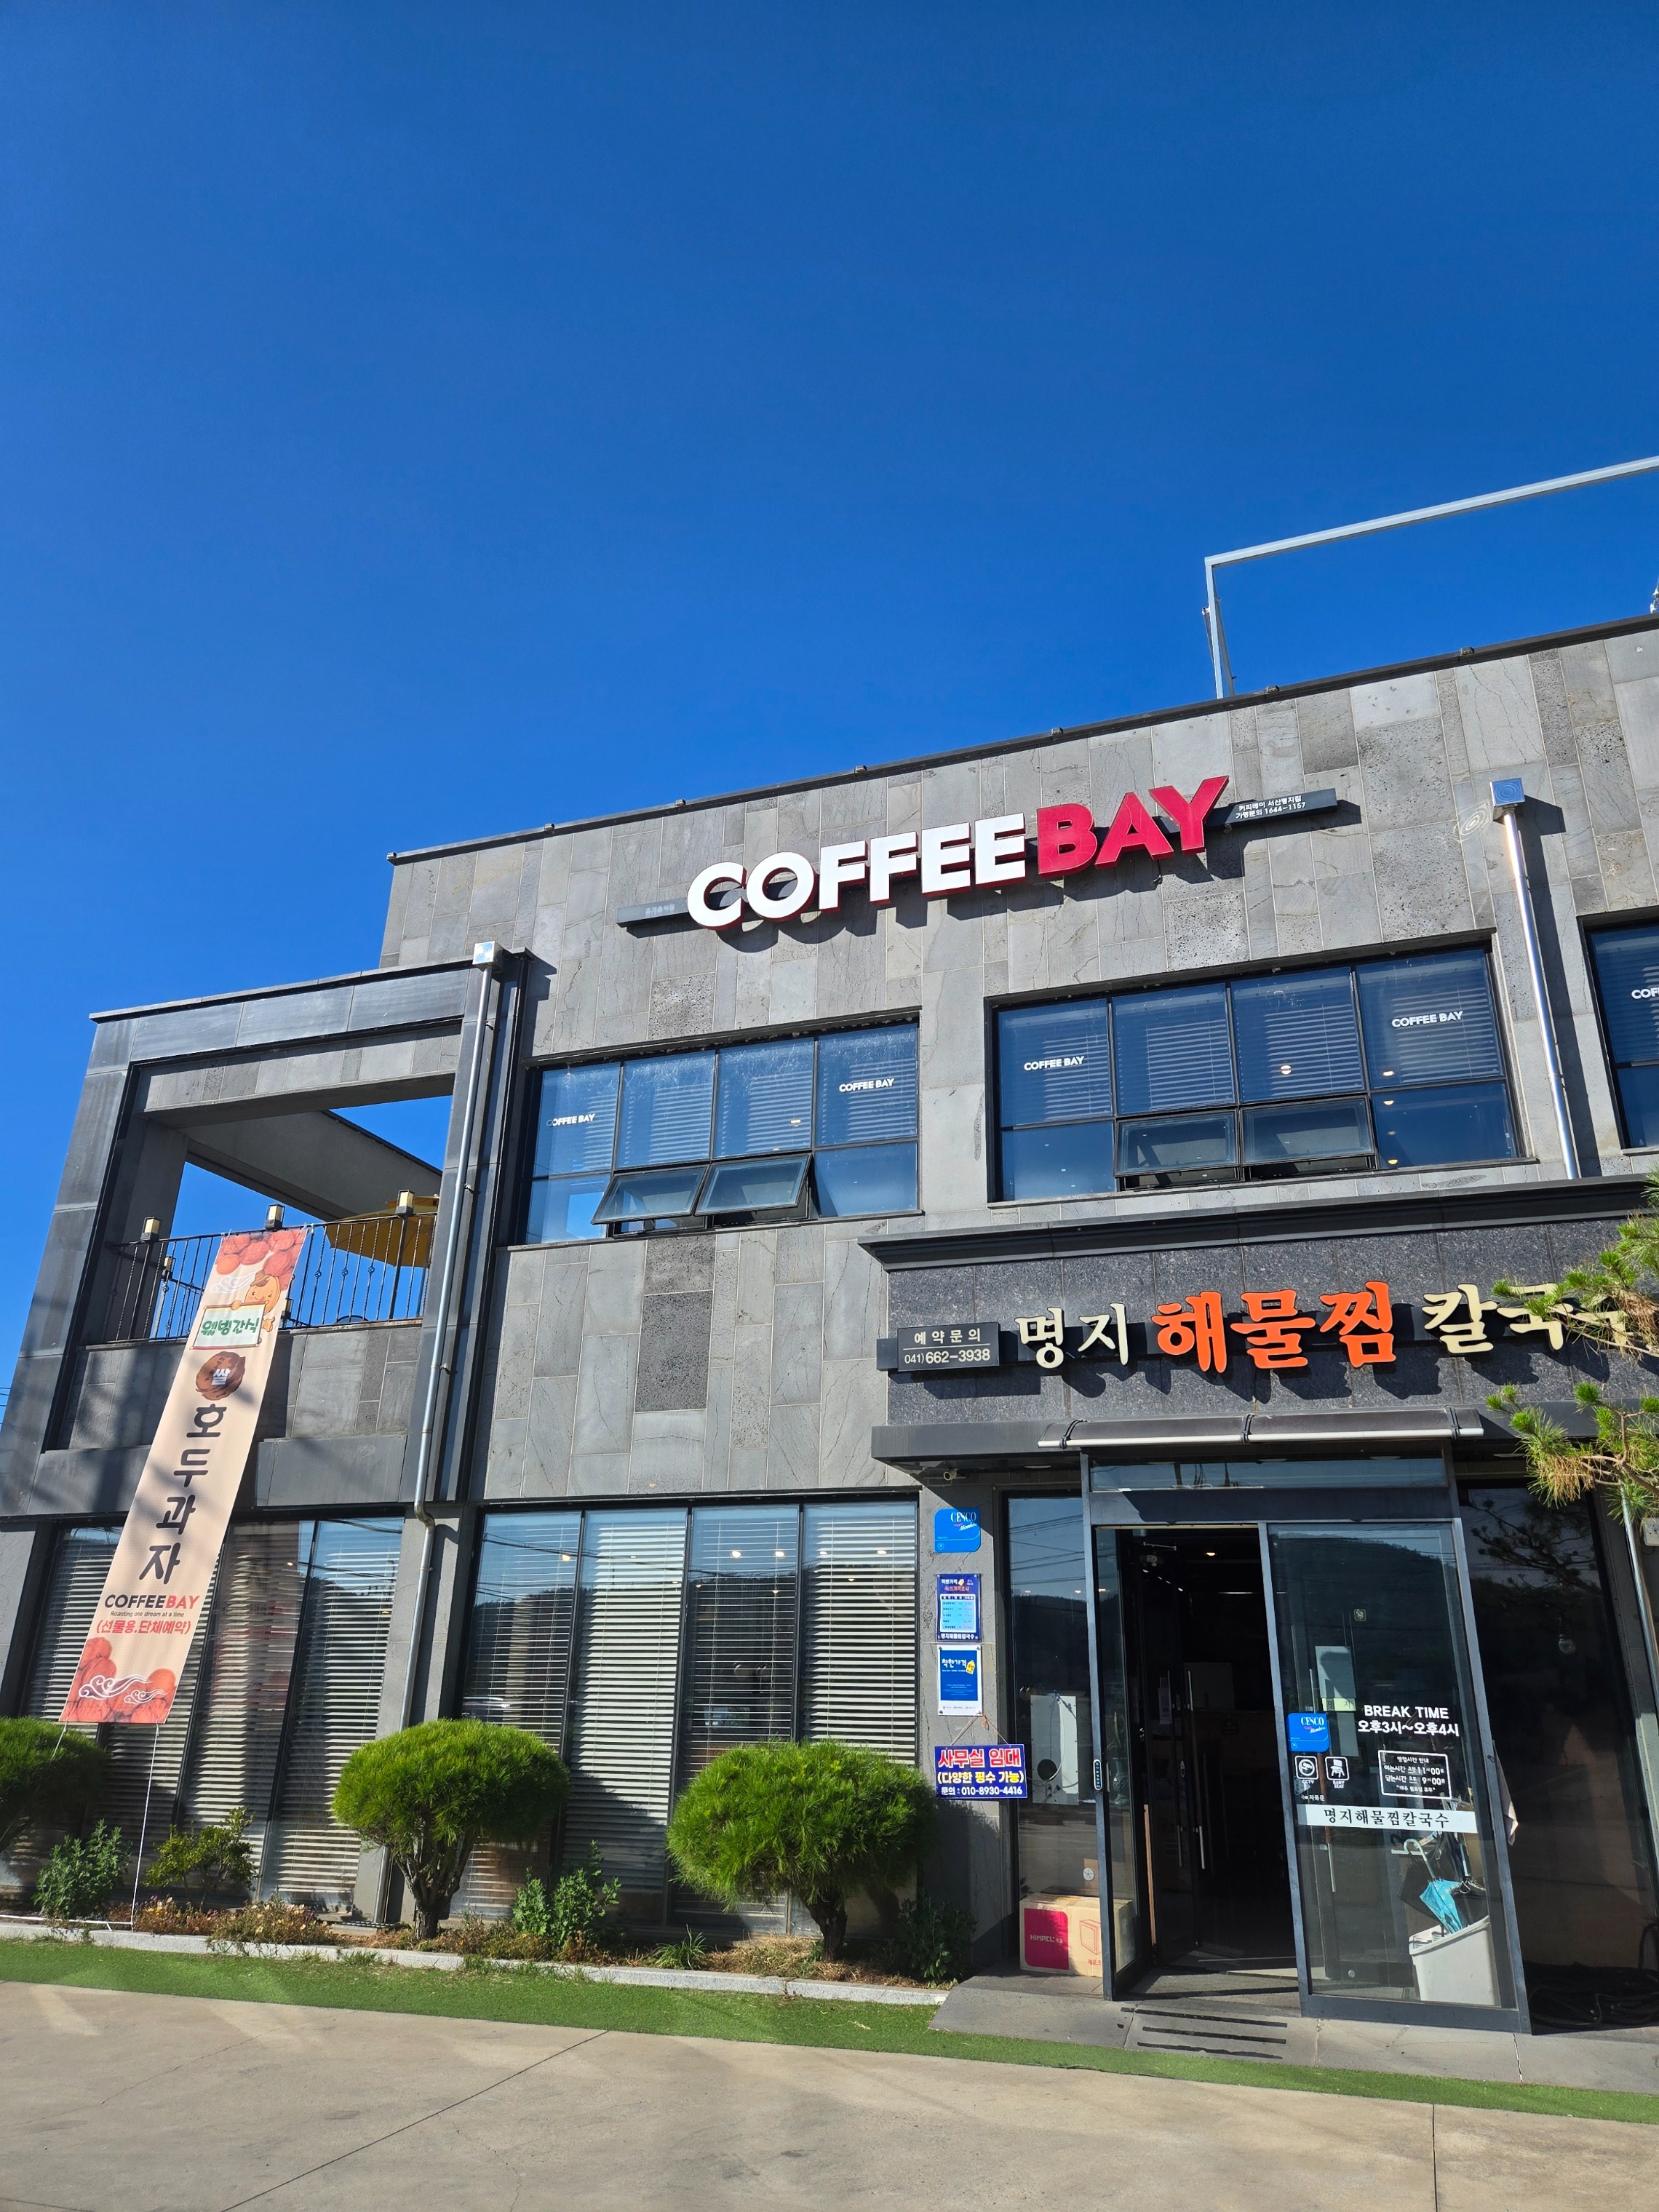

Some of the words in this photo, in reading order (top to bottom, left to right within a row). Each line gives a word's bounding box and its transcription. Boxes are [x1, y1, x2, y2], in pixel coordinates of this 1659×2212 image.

[1265, 801, 1306, 815] 1644-1157
[1631, 987, 1659, 1000] COF
[1391, 1014, 1437, 1027] COFFEE
[1439, 1011, 1463, 1022] BAY
[1024, 1059, 1062, 1071] COFFEE
[1064, 1056, 1084, 1067] BAY
[839, 1081, 874, 1092] COFFEE
[875, 1078, 895, 1089] BAY
[546, 1116, 577, 1127] COFFEE
[578, 1113, 596, 1123] BAY
[201, 1317, 260, 1336] 웰빙간식
[1151, 1281, 1396, 1373] 해물찜
[211, 1368, 231, 1385] 쌀
[950, 1511, 976, 1522] CESCO
[942, 1658, 966, 1668] 착한가격
[1364, 1705, 1412, 1717] BREAK
[1415, 1706, 1449, 1719] TIME
[1300, 1716, 1324, 1726] CESCO
[938, 1748, 985, 1768] 사무실
[989, 1748, 1022, 1767] 임대
[1384, 1765, 1406, 1773] 여는시간
[937, 1771, 972, 1784] (다양한
[975, 1771, 996, 1783] 평수
[998, 1770, 1025, 1783] 가능)
[1385, 1775, 1407, 1783] 닫는시간
[941, 1786, 955, 1795] 문의
[961, 1786, 1023, 1795] 010-8930-4416
[1324, 1807, 1449, 1829] 명지해물찜칼국수
[1030, 1934, 1055, 1943] HIMPEL
